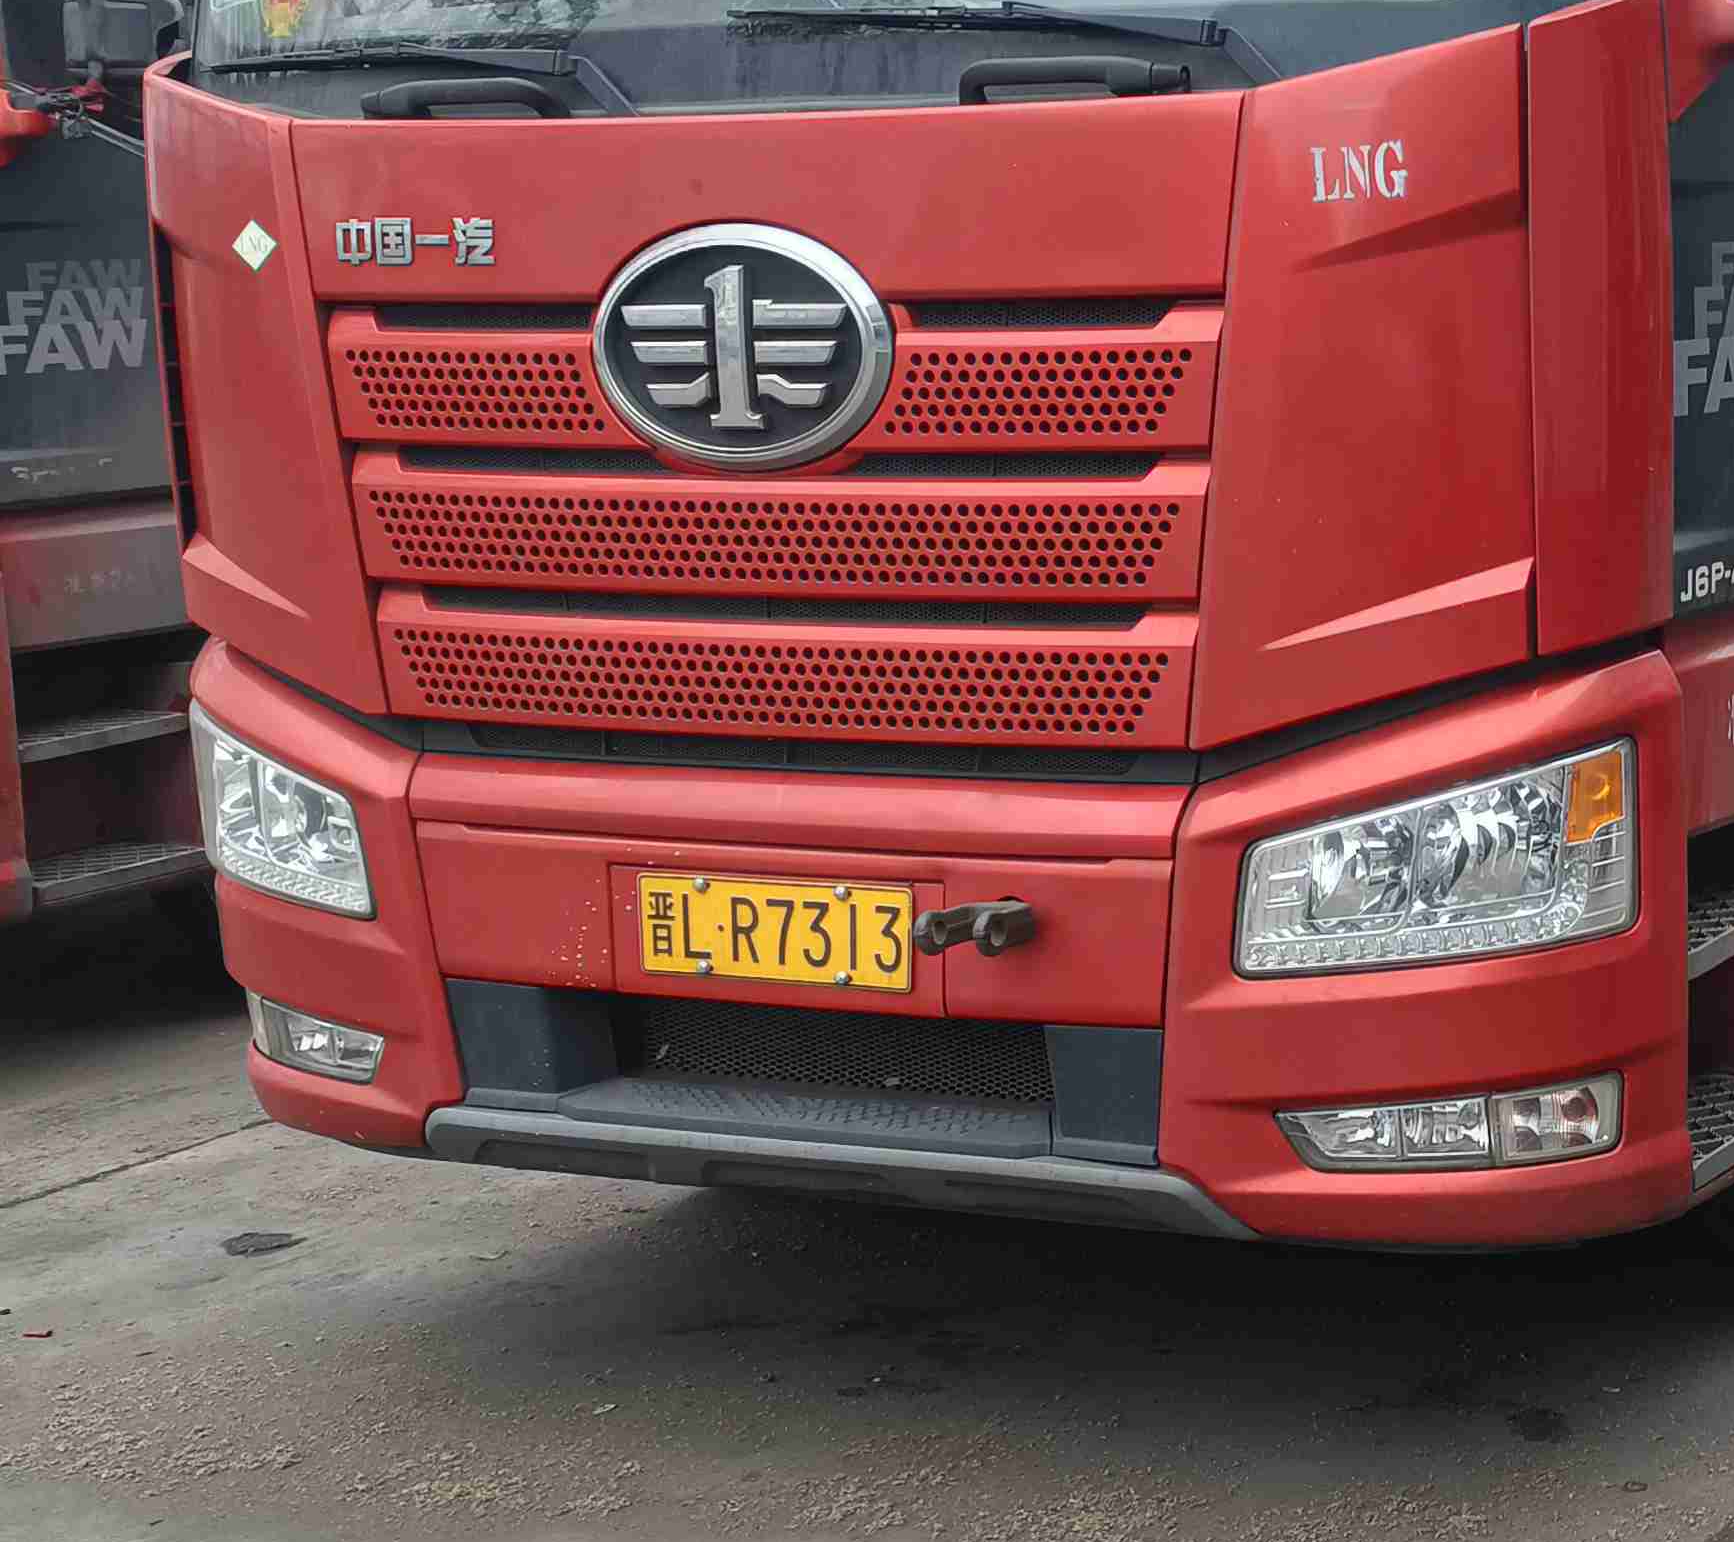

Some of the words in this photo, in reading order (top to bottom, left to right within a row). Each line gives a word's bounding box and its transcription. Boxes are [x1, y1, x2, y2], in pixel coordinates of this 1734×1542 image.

[1311, 140, 1408, 202] LNG
[336, 217, 495, 266] 中国一汽
[26, 259, 141, 291] FAW
[6, 286, 144, 326] FAW
[0, 319, 147, 375] FAW
